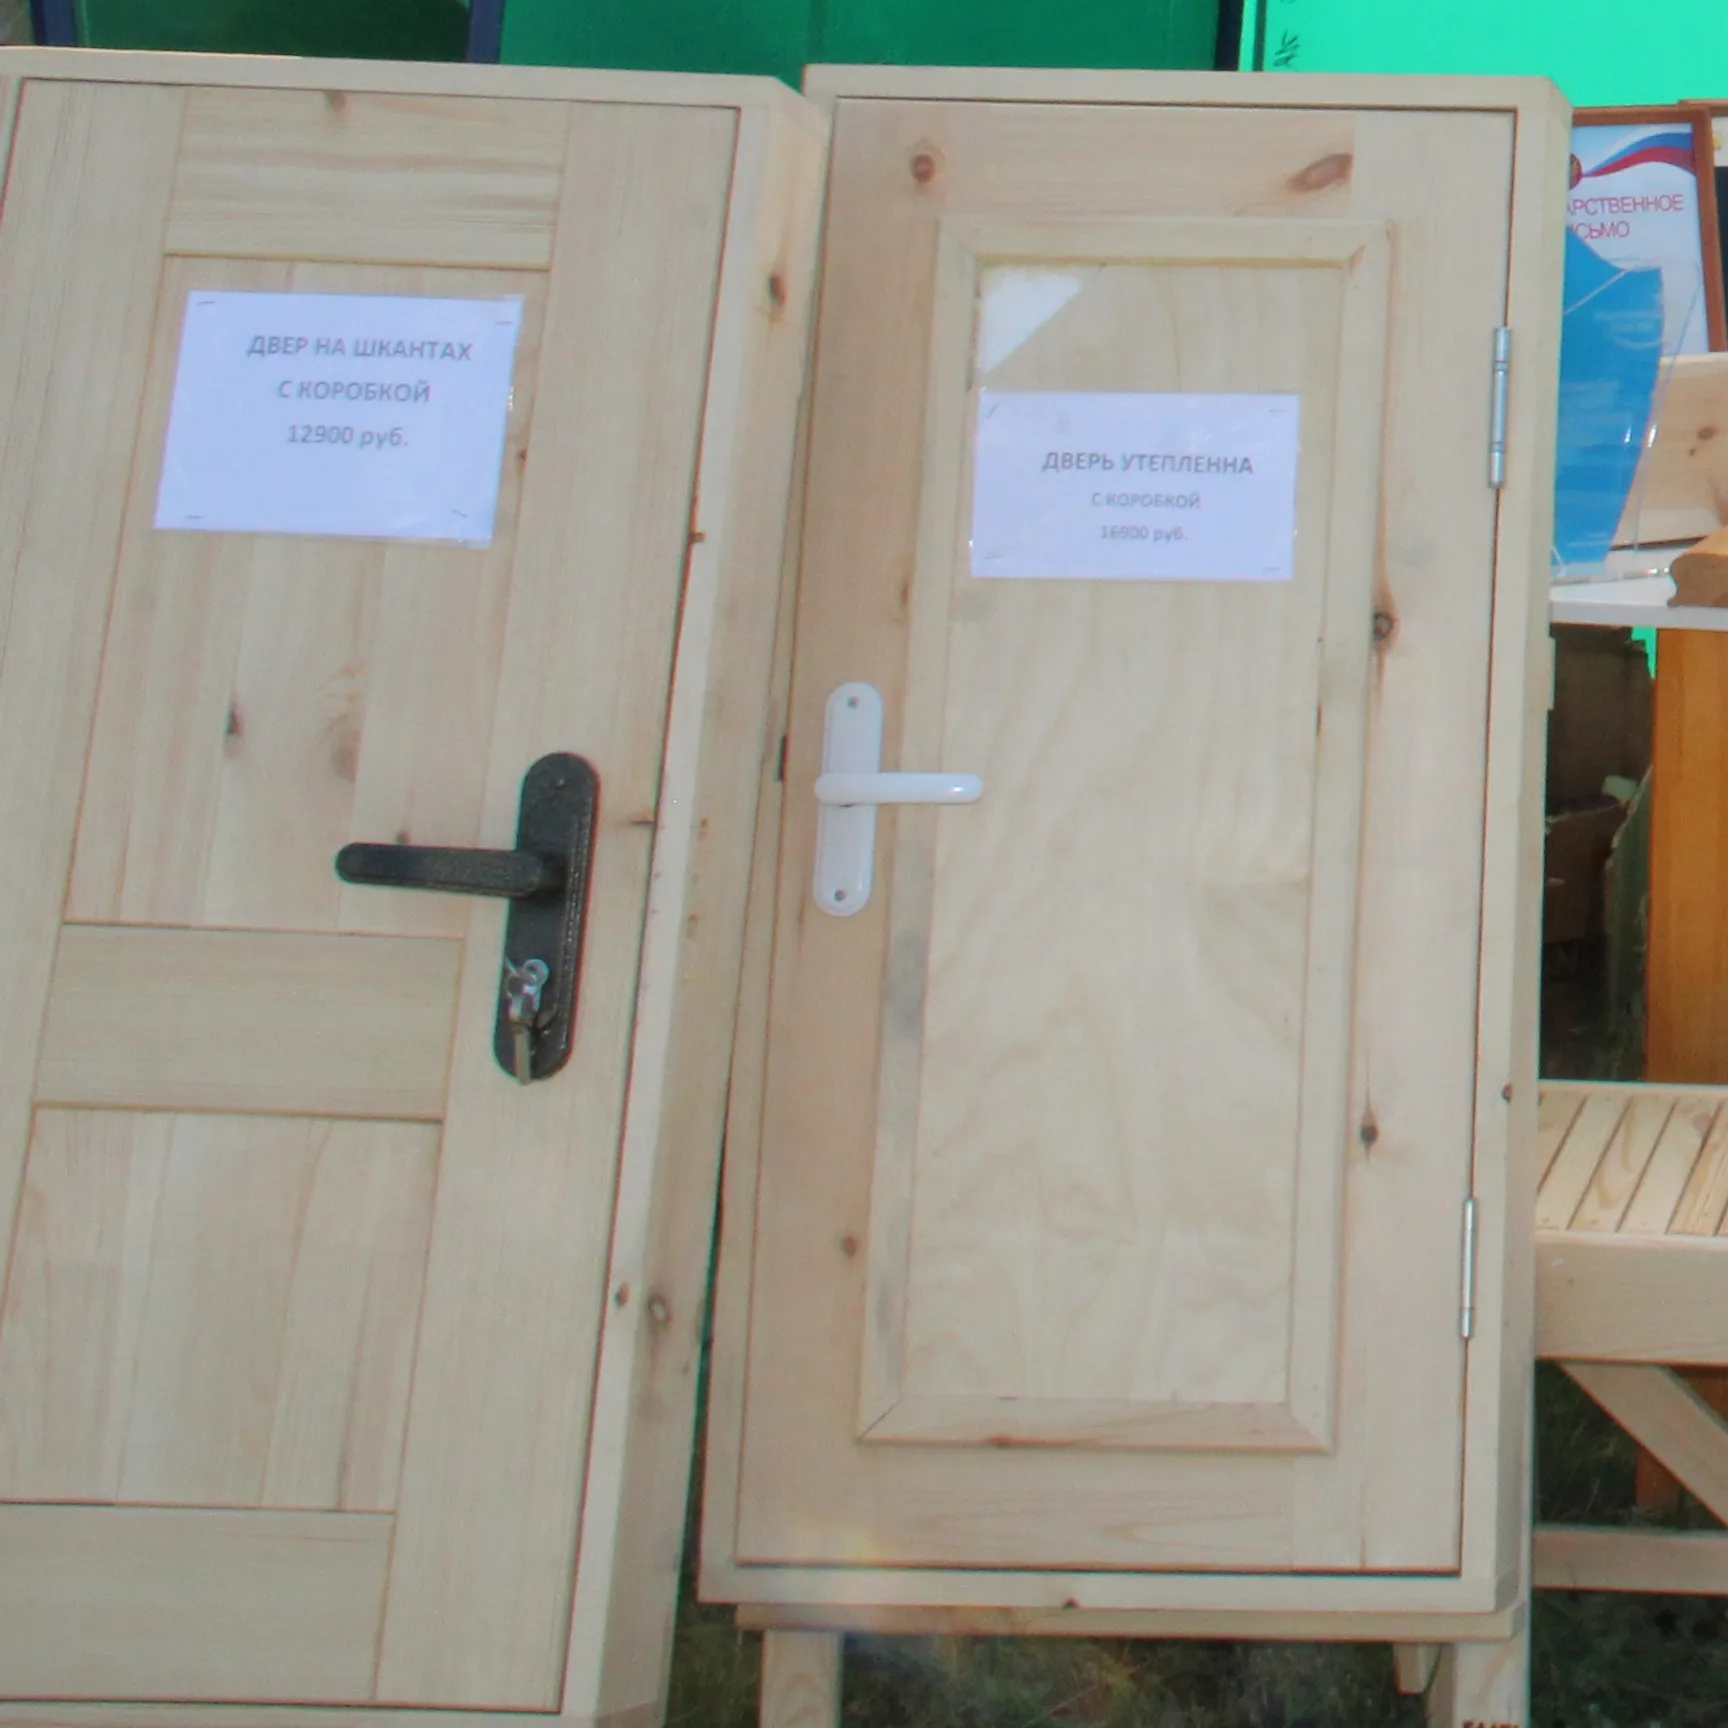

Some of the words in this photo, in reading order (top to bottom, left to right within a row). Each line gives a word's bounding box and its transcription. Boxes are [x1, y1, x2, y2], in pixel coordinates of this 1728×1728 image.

[1571, 221, 1630, 239] СЬМО
[247, 335, 308, 358] ДВЕР
[315, 338, 346, 356] НА
[353, 339, 473, 361] ШКАНТАХ
[277, 380, 293, 399] С
[299, 380, 431, 403] КОРОБКОЙ
[287, 425, 354, 444] 12900
[359, 427, 408, 450] руб.
[1041, 452, 1115, 473] ДВЕРЬ
[1121, 453, 1254, 475] УТЕПЛЕННА
[1091, 492, 1101, 507] С
[1106, 493, 1200, 509] КОРОБКОЙ
[1153, 527, 1188, 543] руб.
